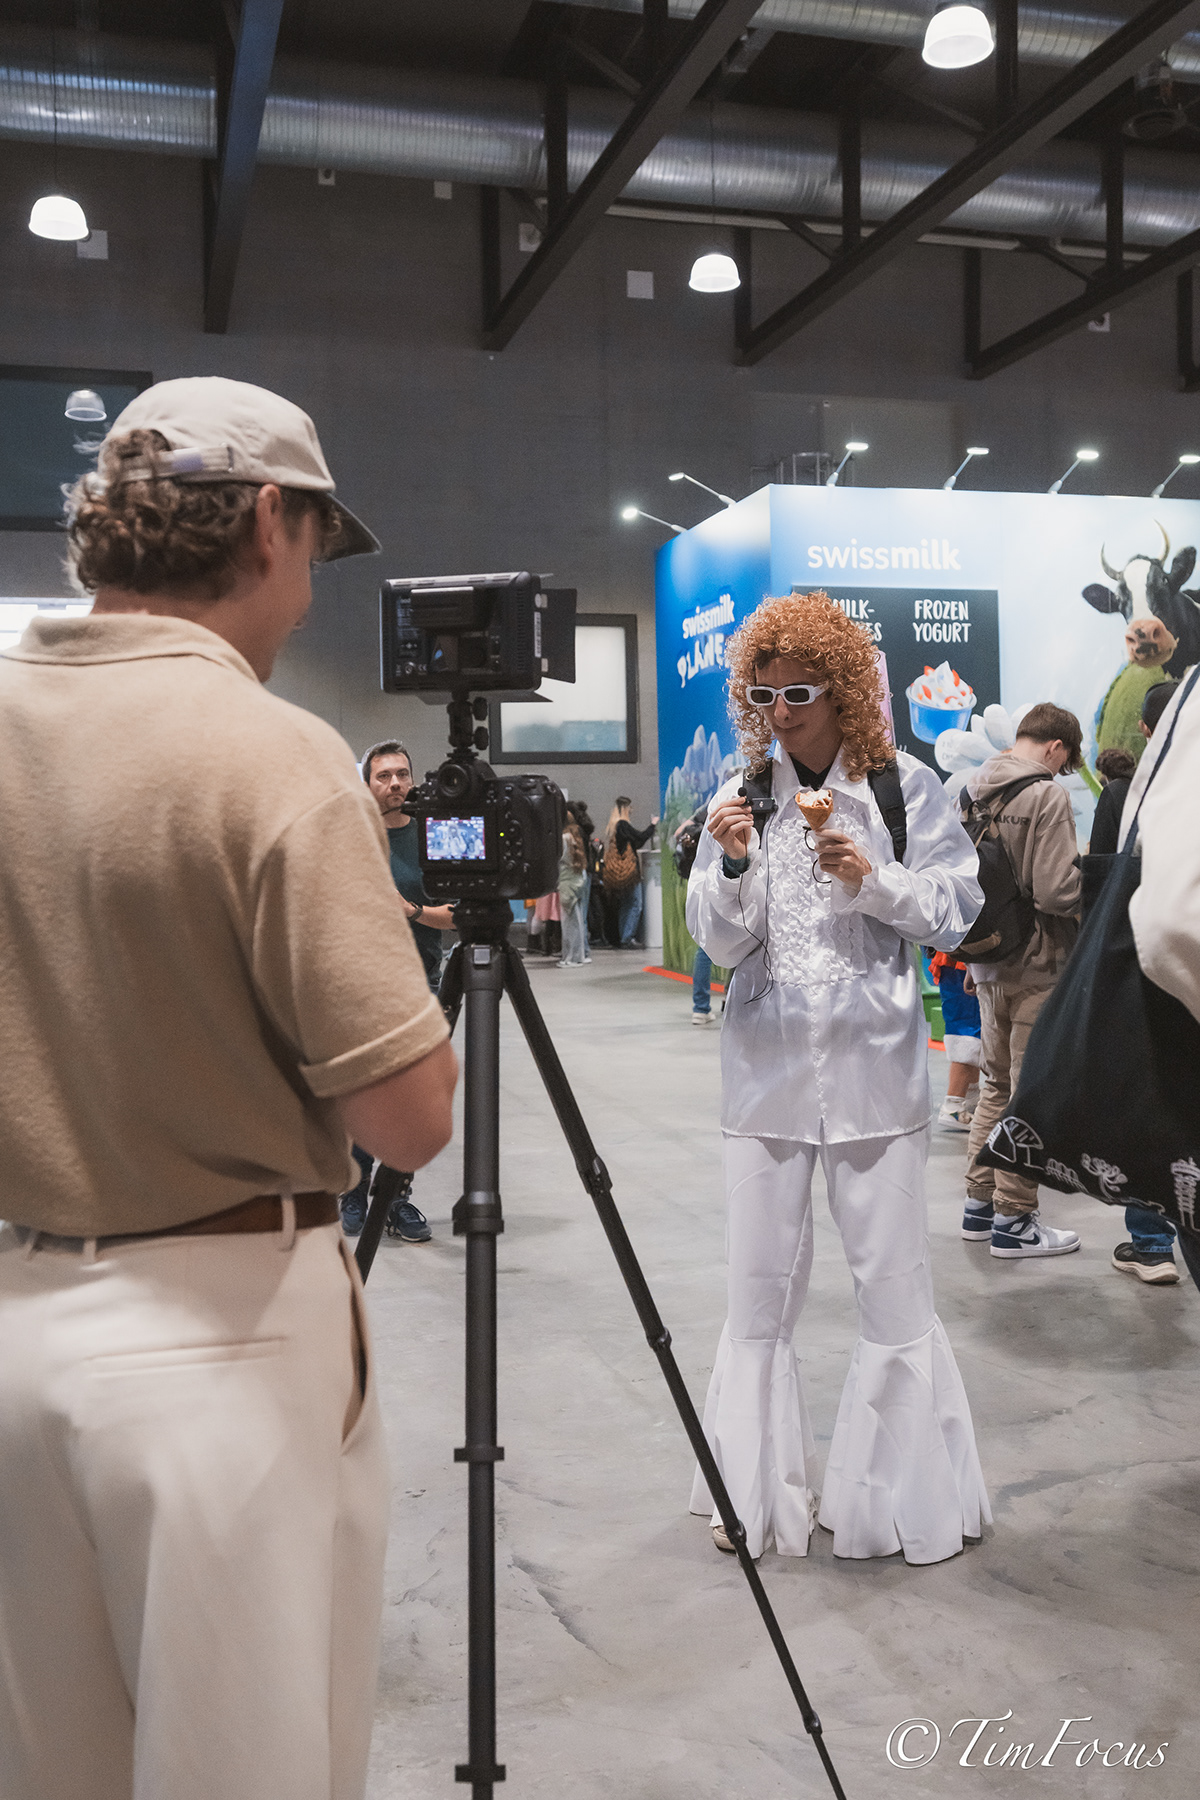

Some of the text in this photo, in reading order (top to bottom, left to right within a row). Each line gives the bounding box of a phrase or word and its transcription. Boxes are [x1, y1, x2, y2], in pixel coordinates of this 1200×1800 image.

[807, 538, 961, 570] swissmilk
[682, 593, 735, 639] swissmilk
[914, 599, 969, 620] FROZEN
[912, 622, 972, 643] YOGURT
[677, 632, 731, 688] PLANE
